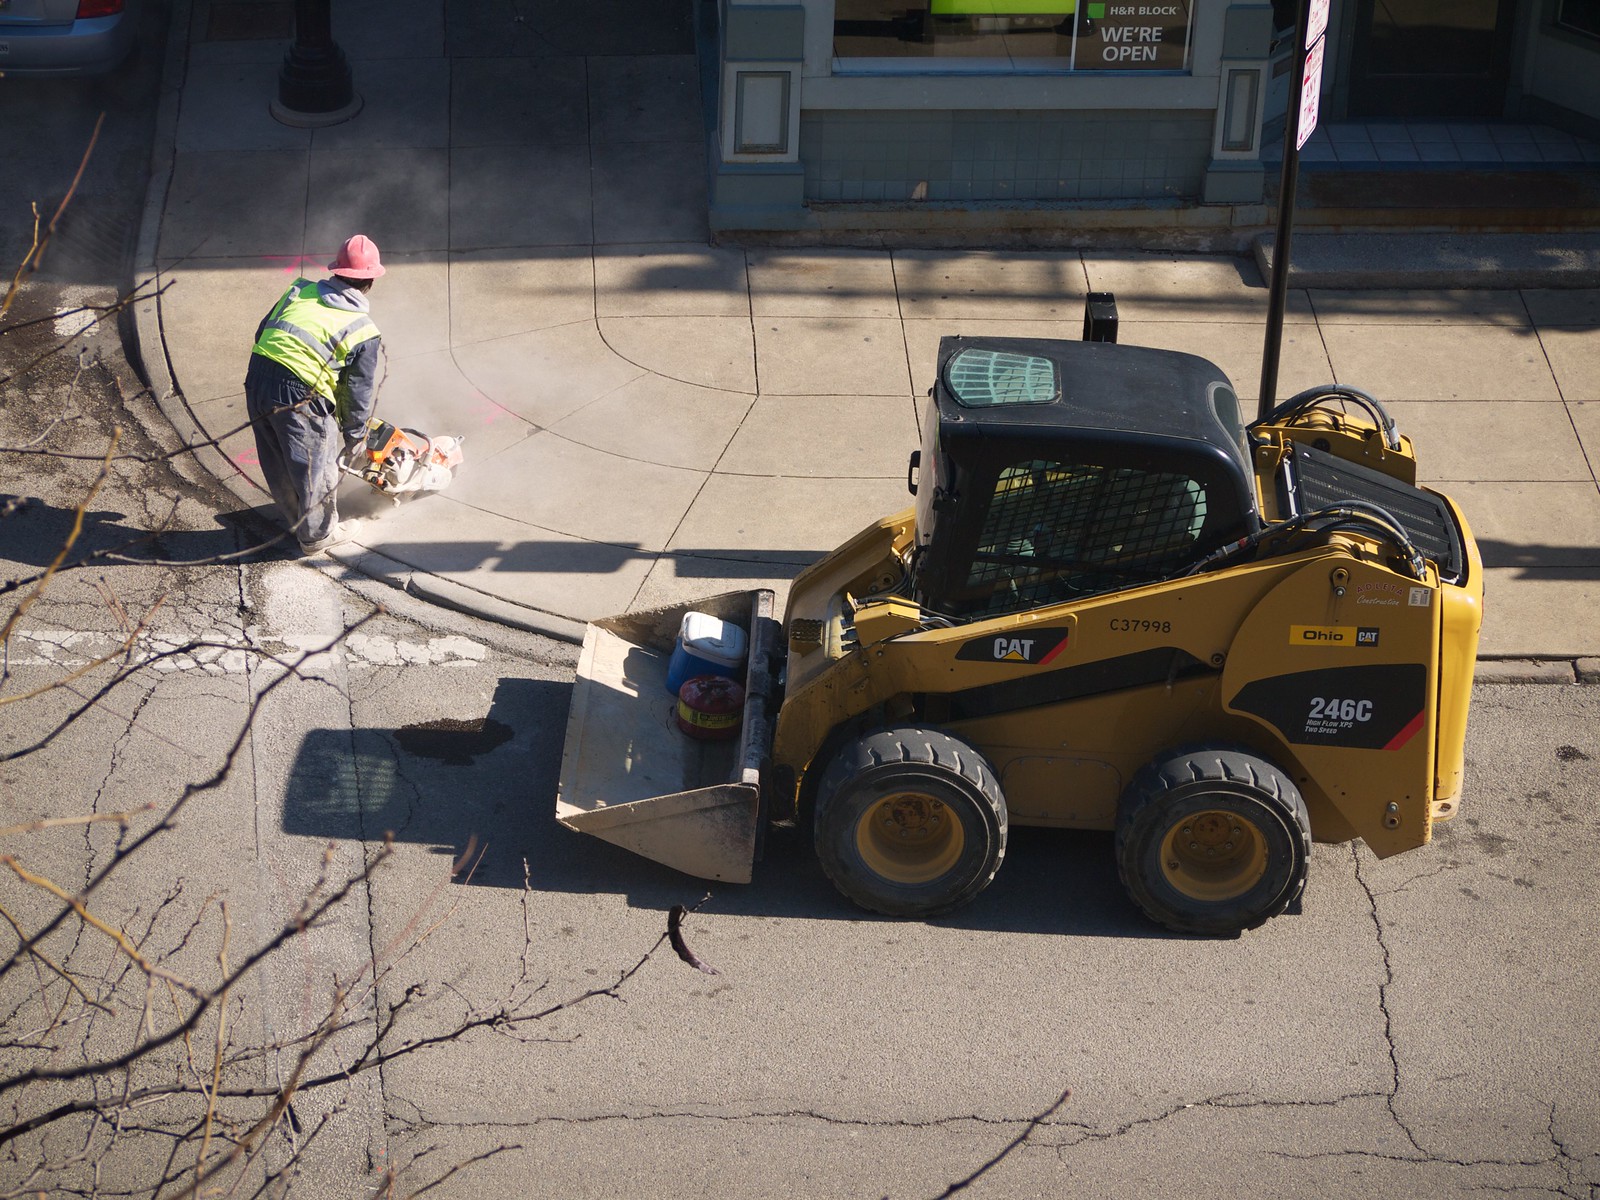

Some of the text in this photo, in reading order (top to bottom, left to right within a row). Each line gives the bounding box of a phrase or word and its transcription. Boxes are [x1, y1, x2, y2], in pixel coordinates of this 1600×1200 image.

[1110, 6, 1177, 15] H&R BLOCK
[1101, 26, 1163, 42] WE'RE
[1102, 46, 1157, 61] OPEN
[1356, 595, 1400, 606] Construction
[1109, 618, 1172, 634] C37998
[1303, 630, 1377, 642] Ohio CAT
[993, 637, 1035, 661] CAT
[1308, 697, 1373, 722] 246C
[1339, 721, 1354, 729] XPS
